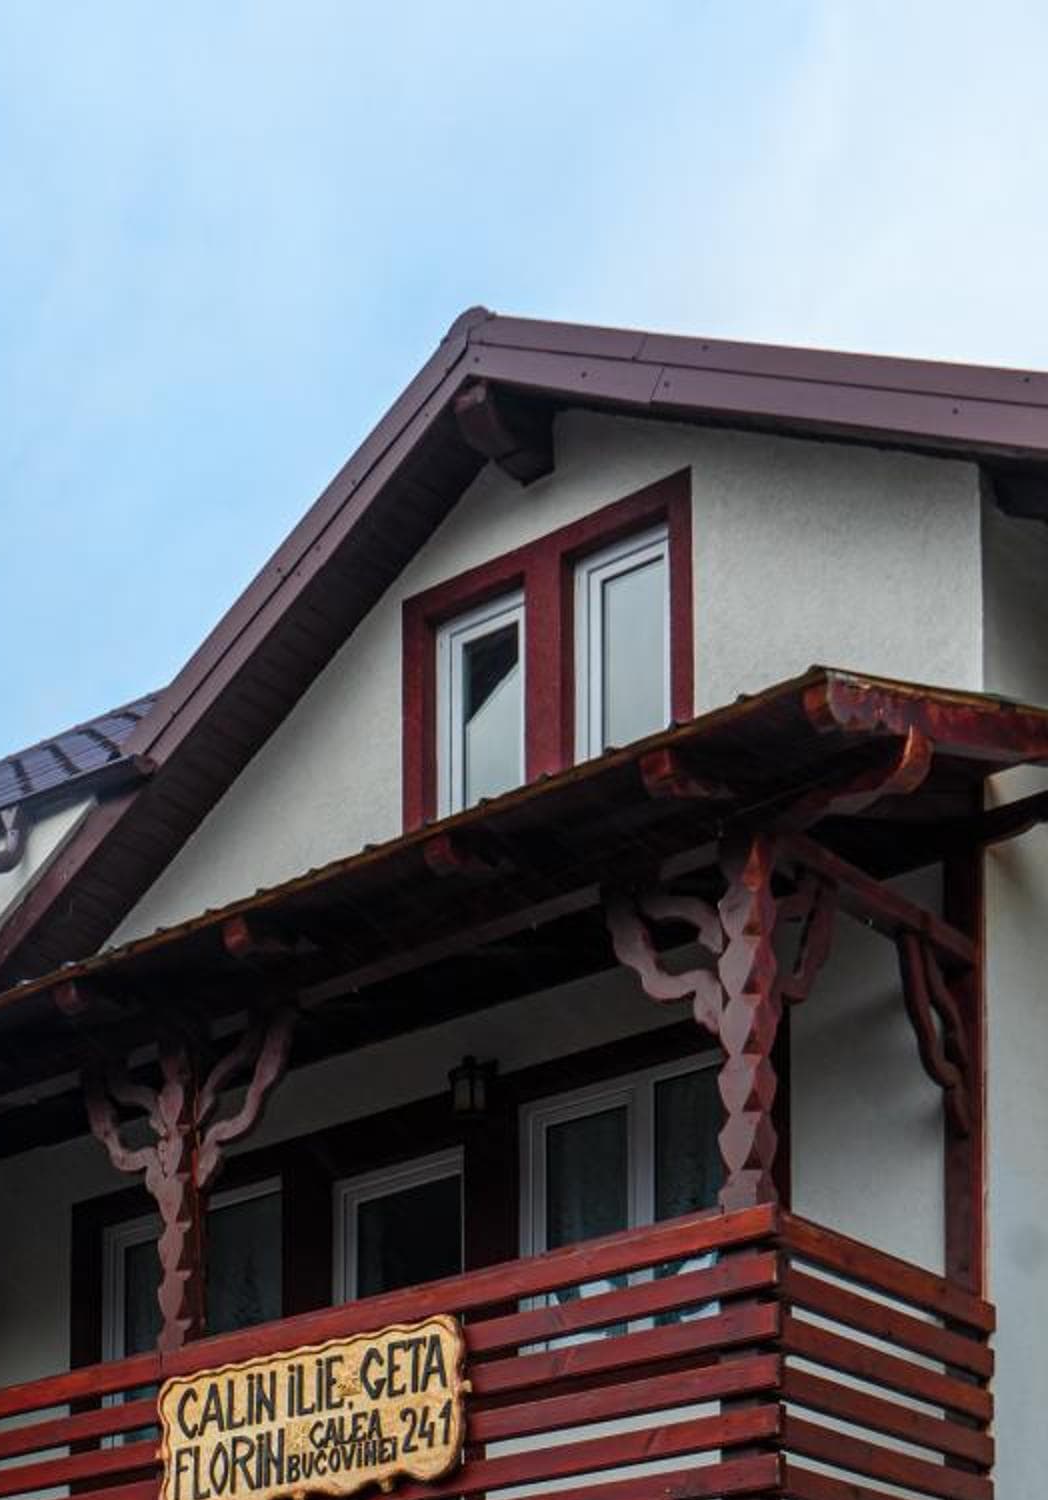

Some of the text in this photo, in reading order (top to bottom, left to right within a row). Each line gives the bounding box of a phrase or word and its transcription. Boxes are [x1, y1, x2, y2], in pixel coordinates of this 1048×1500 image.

[360, 1334, 446, 1400] GETA
[310, 1408, 382, 1449] CALEA
[401, 1399, 452, 1454] 241
